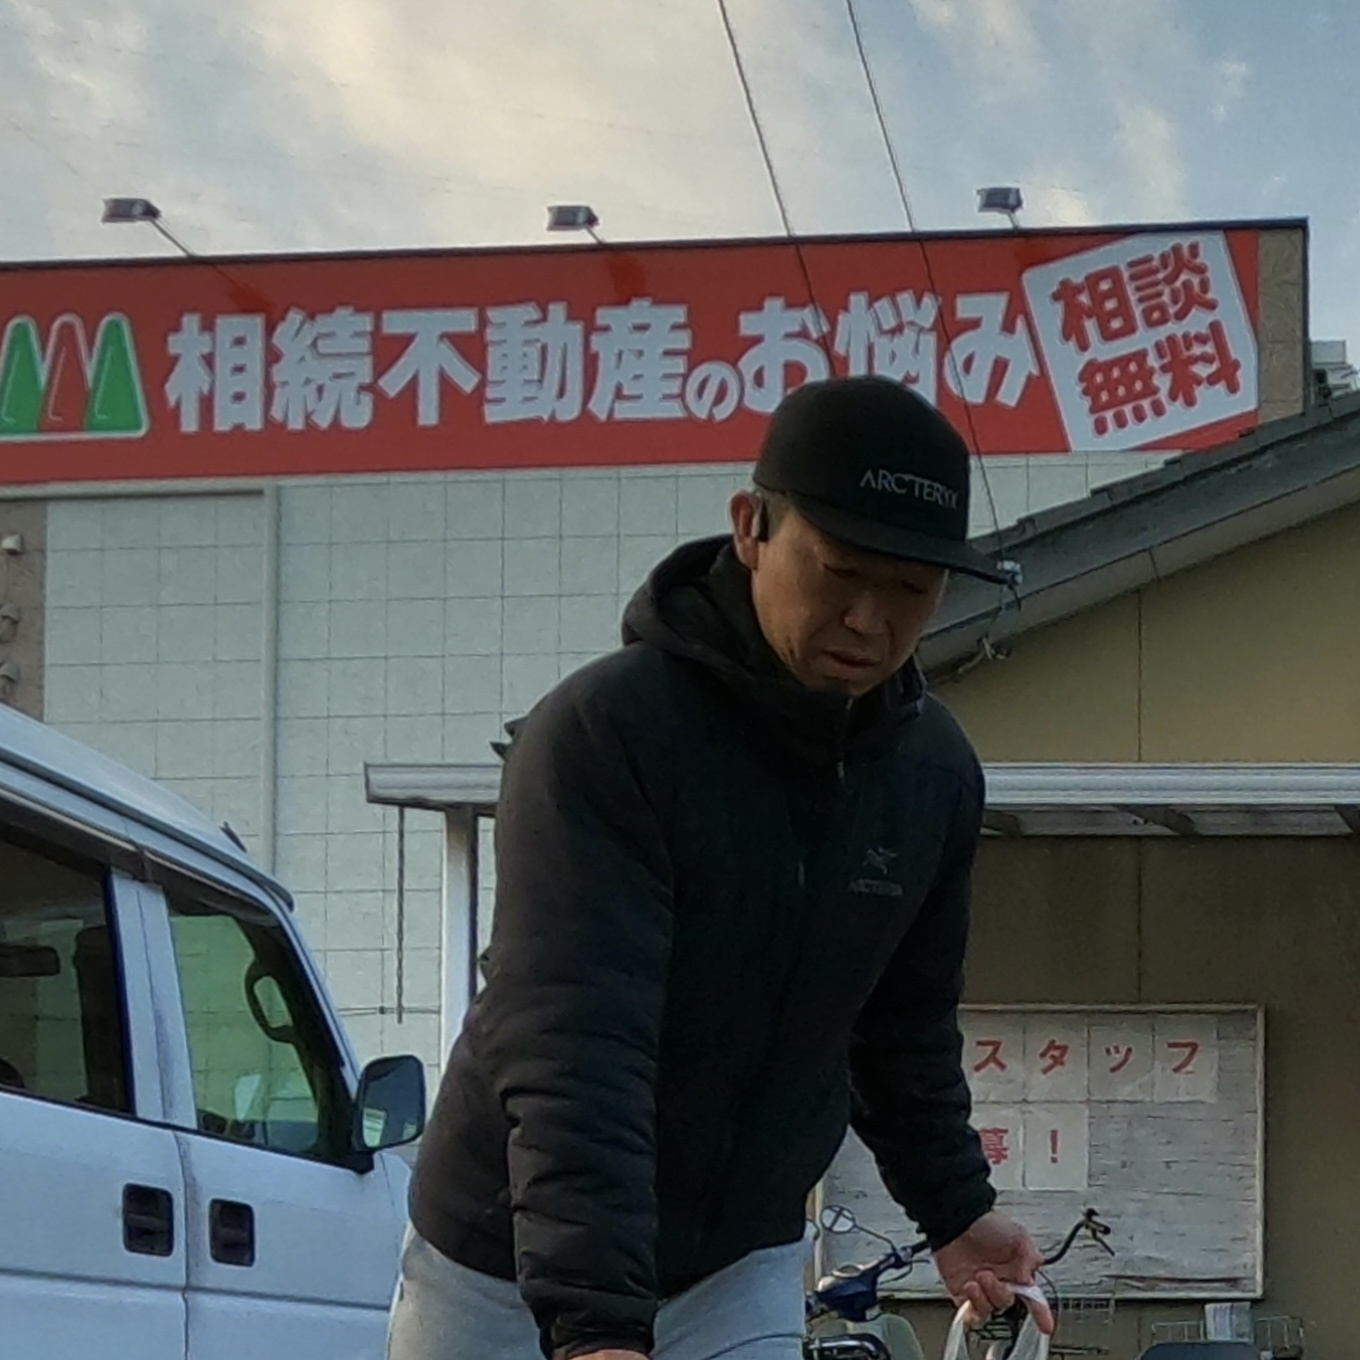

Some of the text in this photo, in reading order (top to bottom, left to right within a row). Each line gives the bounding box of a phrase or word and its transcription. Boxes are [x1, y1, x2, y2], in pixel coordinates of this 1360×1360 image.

[1051, 243, 1219, 352] 相談
[166, 290, 1039, 433] 相続不動産のお悩み
[1076, 320, 1242, 437] 無料
[973, 1038, 1200, 1075] スタッフ
